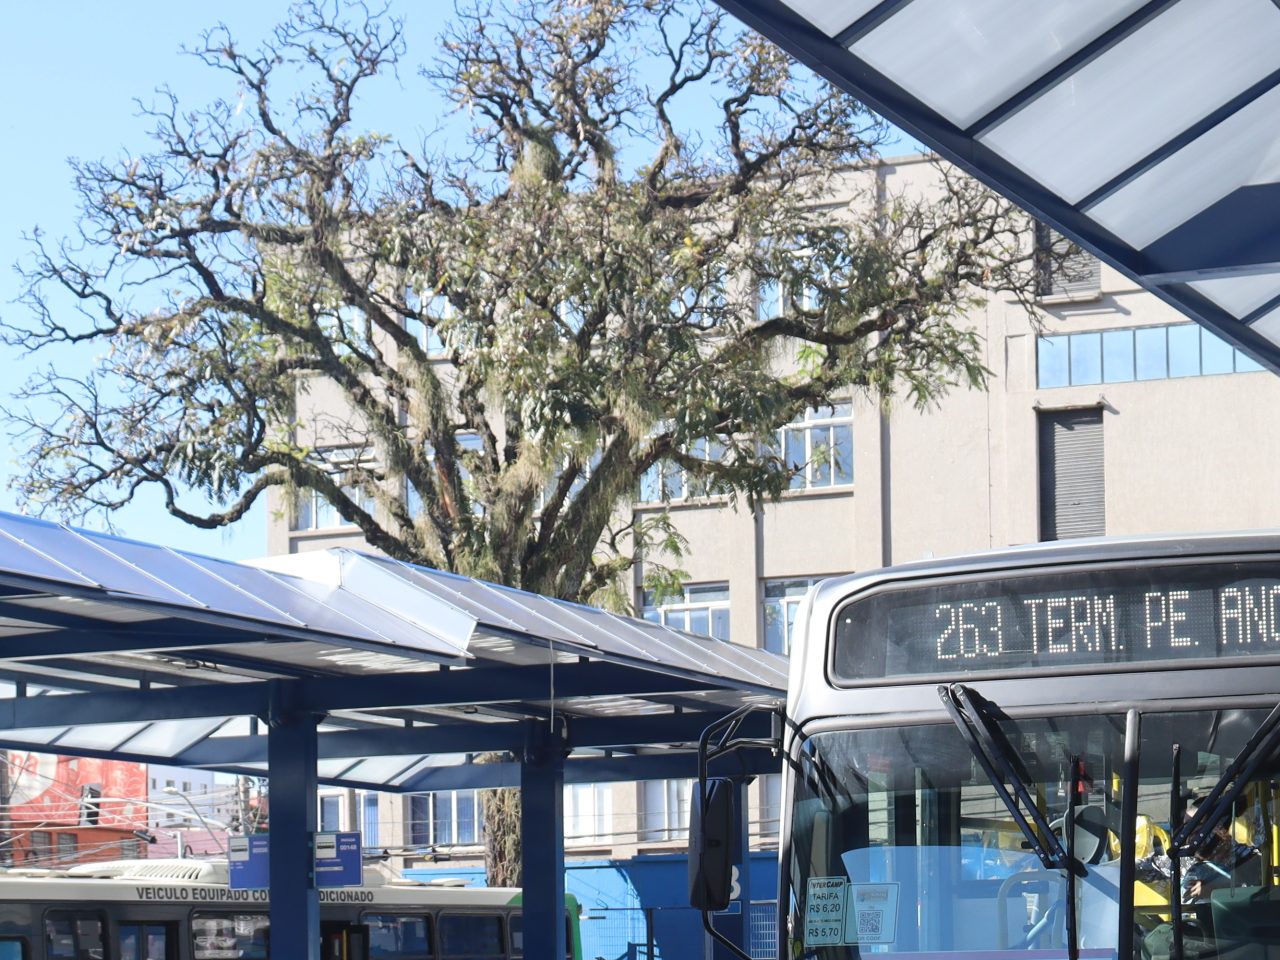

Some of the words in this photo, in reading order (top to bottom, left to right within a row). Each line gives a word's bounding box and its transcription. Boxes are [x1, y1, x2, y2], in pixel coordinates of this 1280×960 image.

[935, 602, 1002, 660] 263
[1024, 595, 1124, 654] TERM.
[1144, 590, 1199, 648] PE.
[136, 887, 188, 900] VEICULO
[192, 888, 249, 901] EQUIPADO
[252, 889, 269, 901] CO
[319, 890, 374, 903] DICIONADO
[813, 892, 839, 901] TARIFA
[809, 904, 820, 913] R$
[822, 903, 841, 913] 6,20
[808, 928, 819, 937] R$
